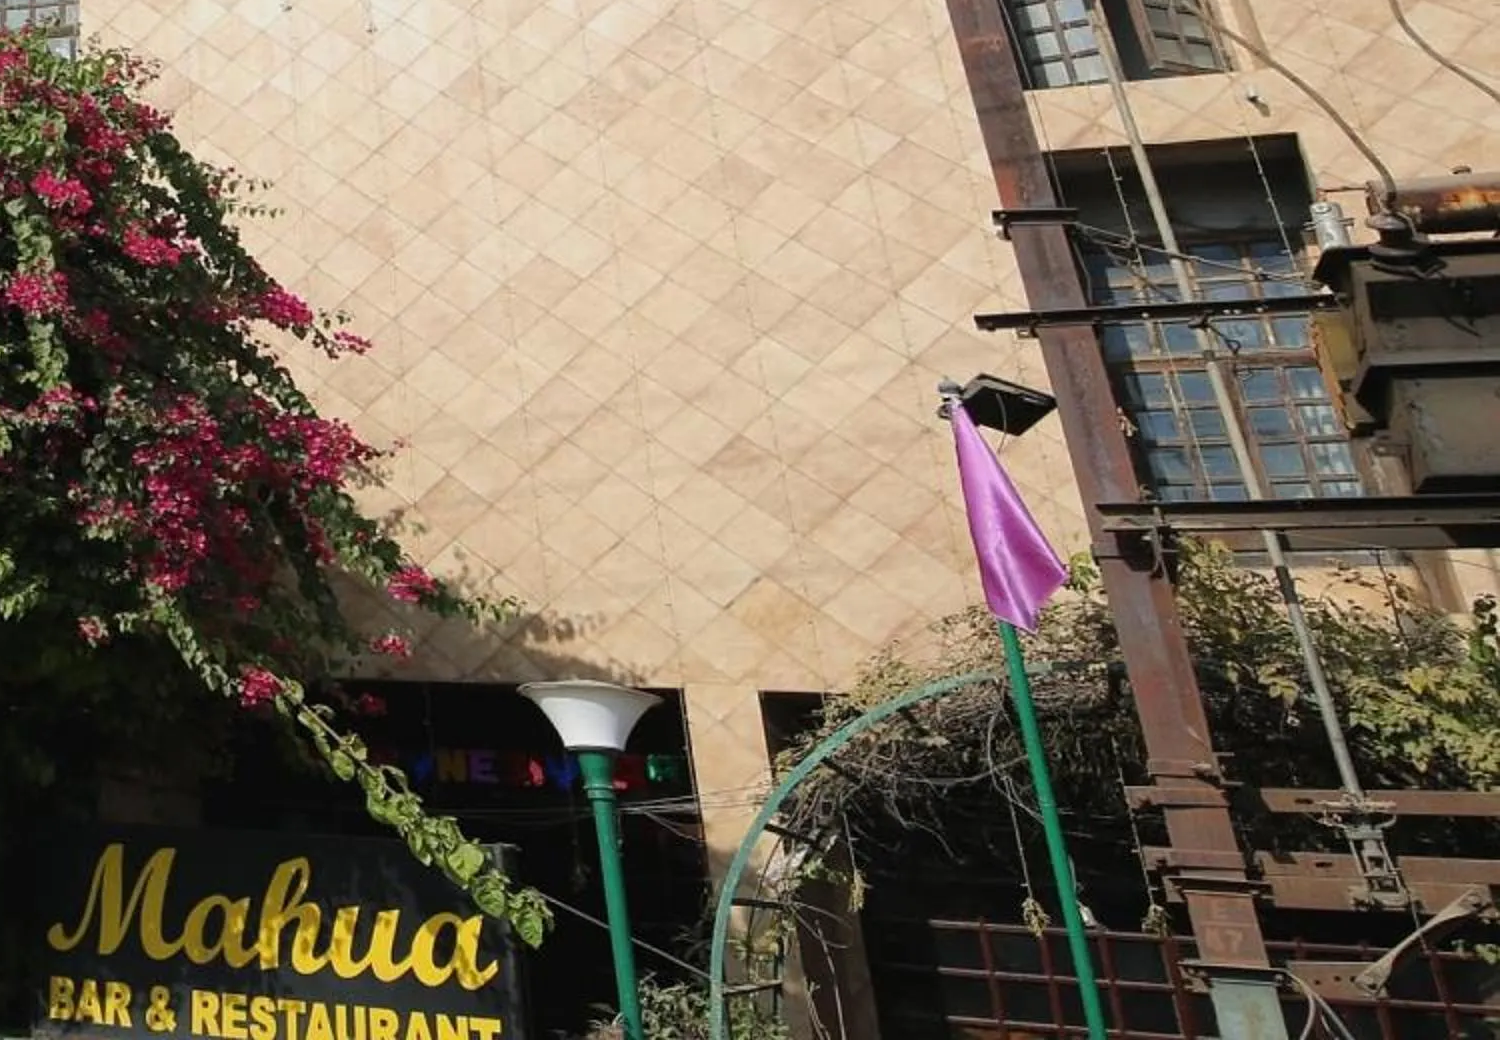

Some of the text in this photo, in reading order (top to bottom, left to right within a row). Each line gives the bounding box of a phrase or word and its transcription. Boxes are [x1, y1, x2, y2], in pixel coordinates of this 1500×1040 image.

[48, 843, 499, 990] Mahua
[49, 976, 133, 1028] BAR
[146, 985, 178, 1033] &
